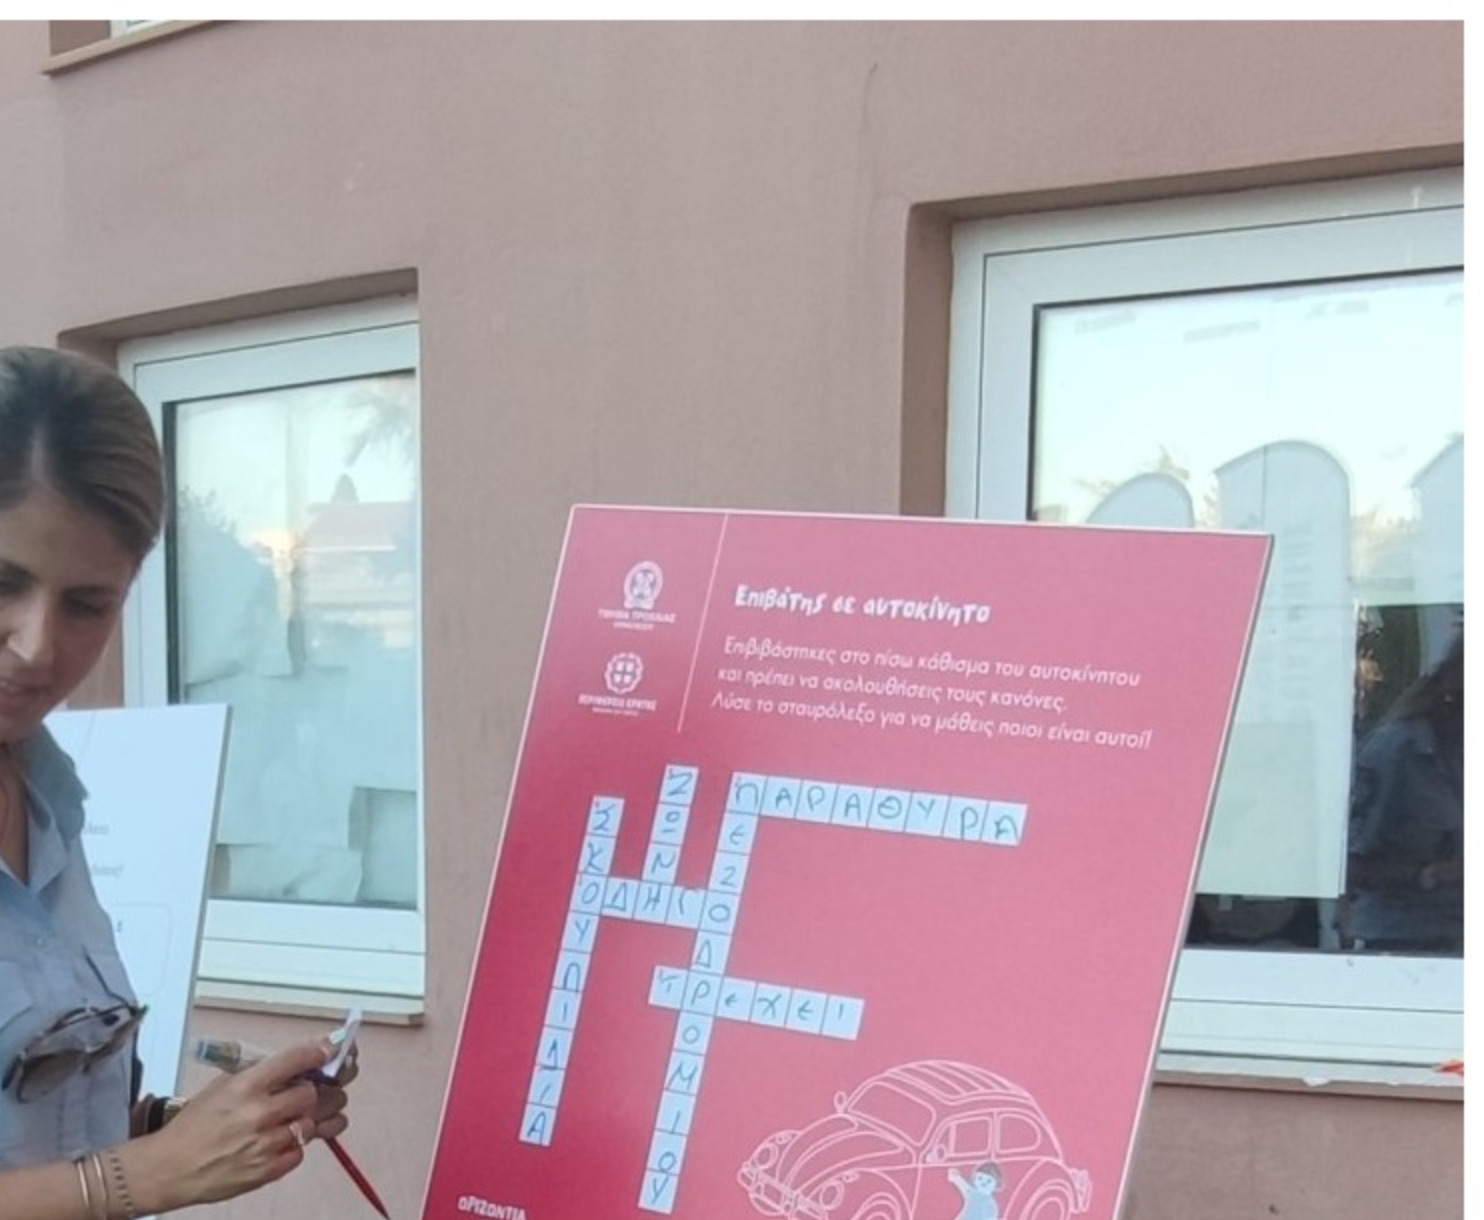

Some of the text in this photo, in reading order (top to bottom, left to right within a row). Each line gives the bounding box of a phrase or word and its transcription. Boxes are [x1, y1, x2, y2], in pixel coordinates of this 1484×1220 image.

[735, 584, 991, 626] Επιβάτης σε αυτοκίνητο
[724, 635, 1141, 686] Επιβιβάστηκες στο πίσω κάθισμα του αυτοκίνητου
[717, 667, 1069, 715] και πρέπει να ακολουθήσεις τους κανόνες.
[711, 690, 1153, 750] Λύσε το σταυρόλεξο για να μάθεις ποιοι είναι αυτοί!
[732, 777, 1020, 841] ΠΑΡΑΘΥΡΑ
